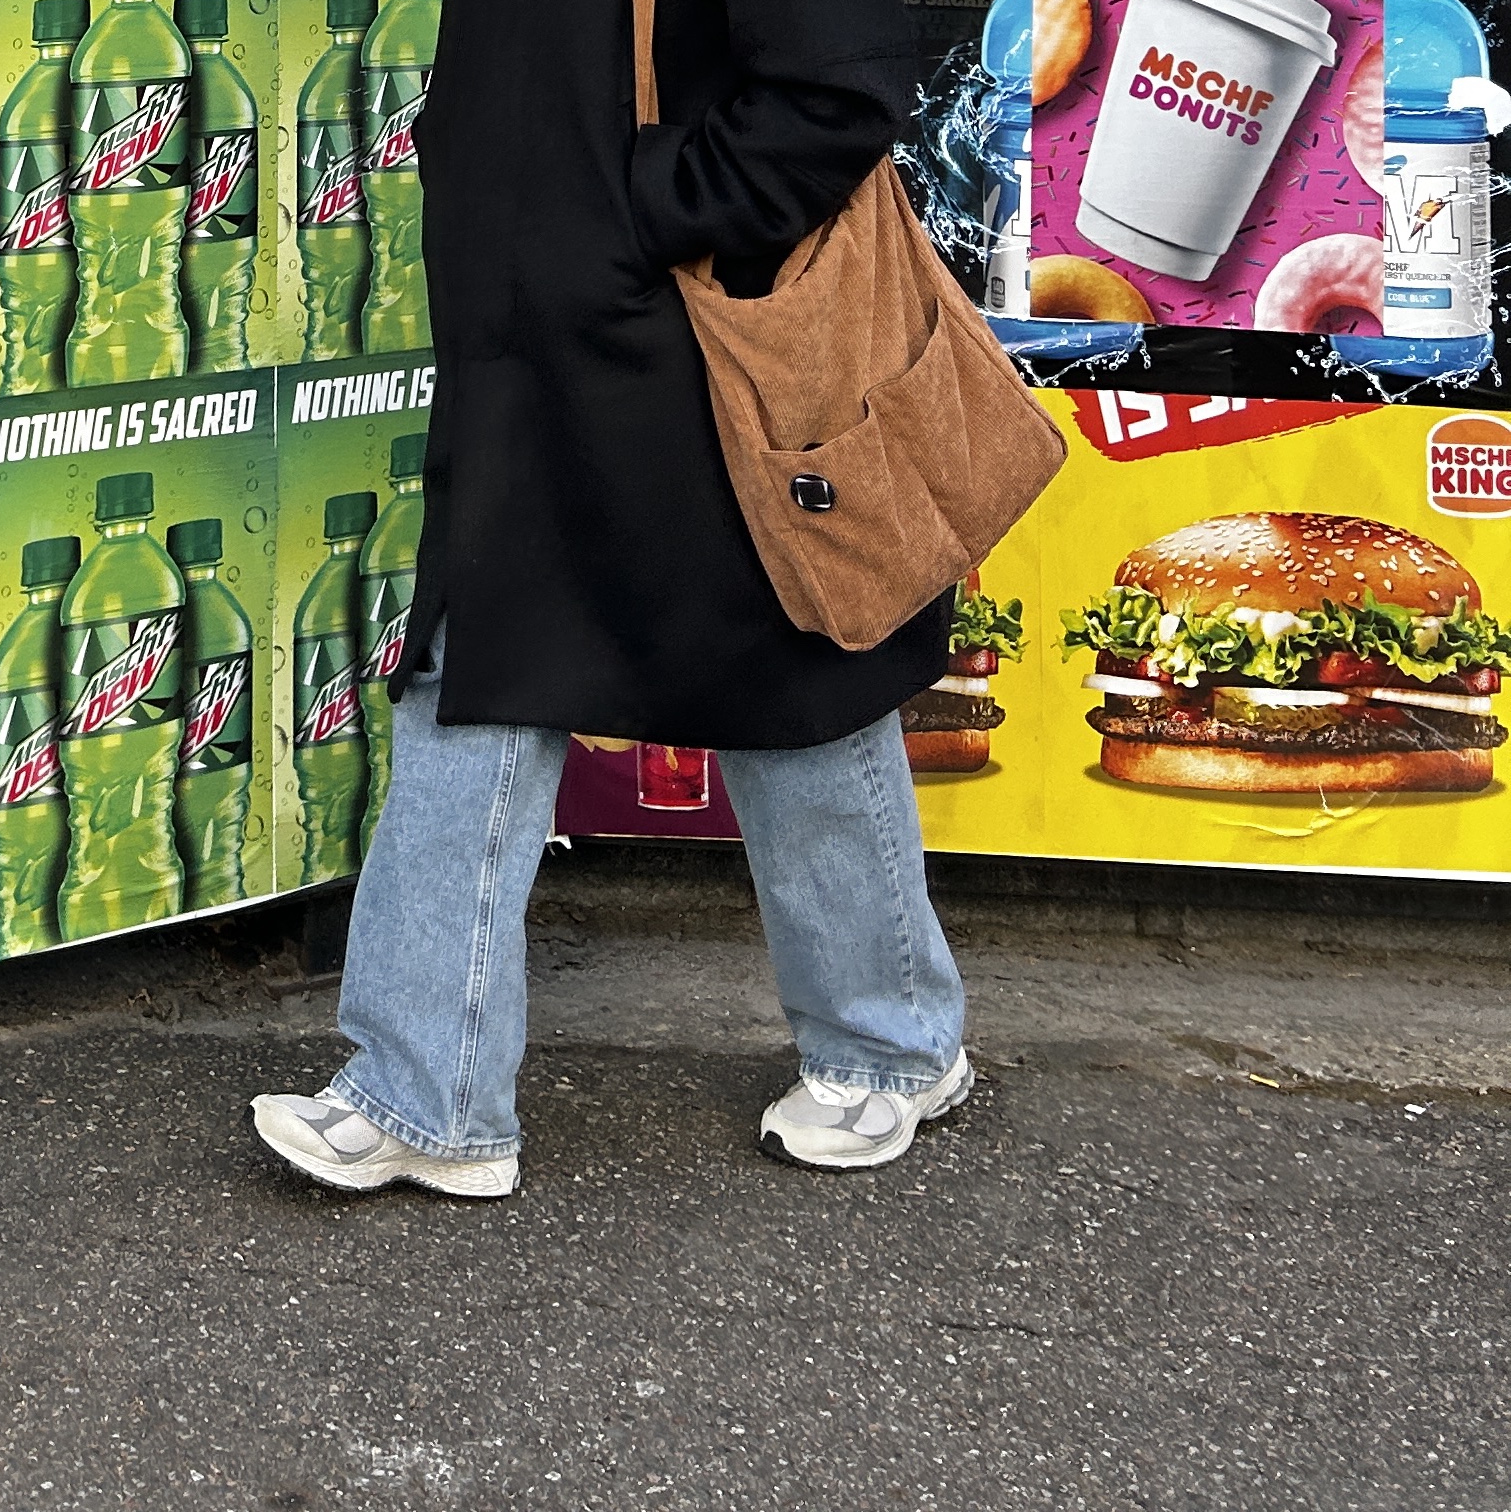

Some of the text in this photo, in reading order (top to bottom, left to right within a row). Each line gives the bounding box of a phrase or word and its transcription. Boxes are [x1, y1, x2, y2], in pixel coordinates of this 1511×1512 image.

[1128, 73, 1263, 147] DONUTS
[1138, 46, 1275, 117] MSCHF
[115, 402, 146, 449] IS
[149, 389, 257, 444] SACRED
[292, 367, 435, 425] NOTHING IS
[1097, 390, 1168, 444] IS
